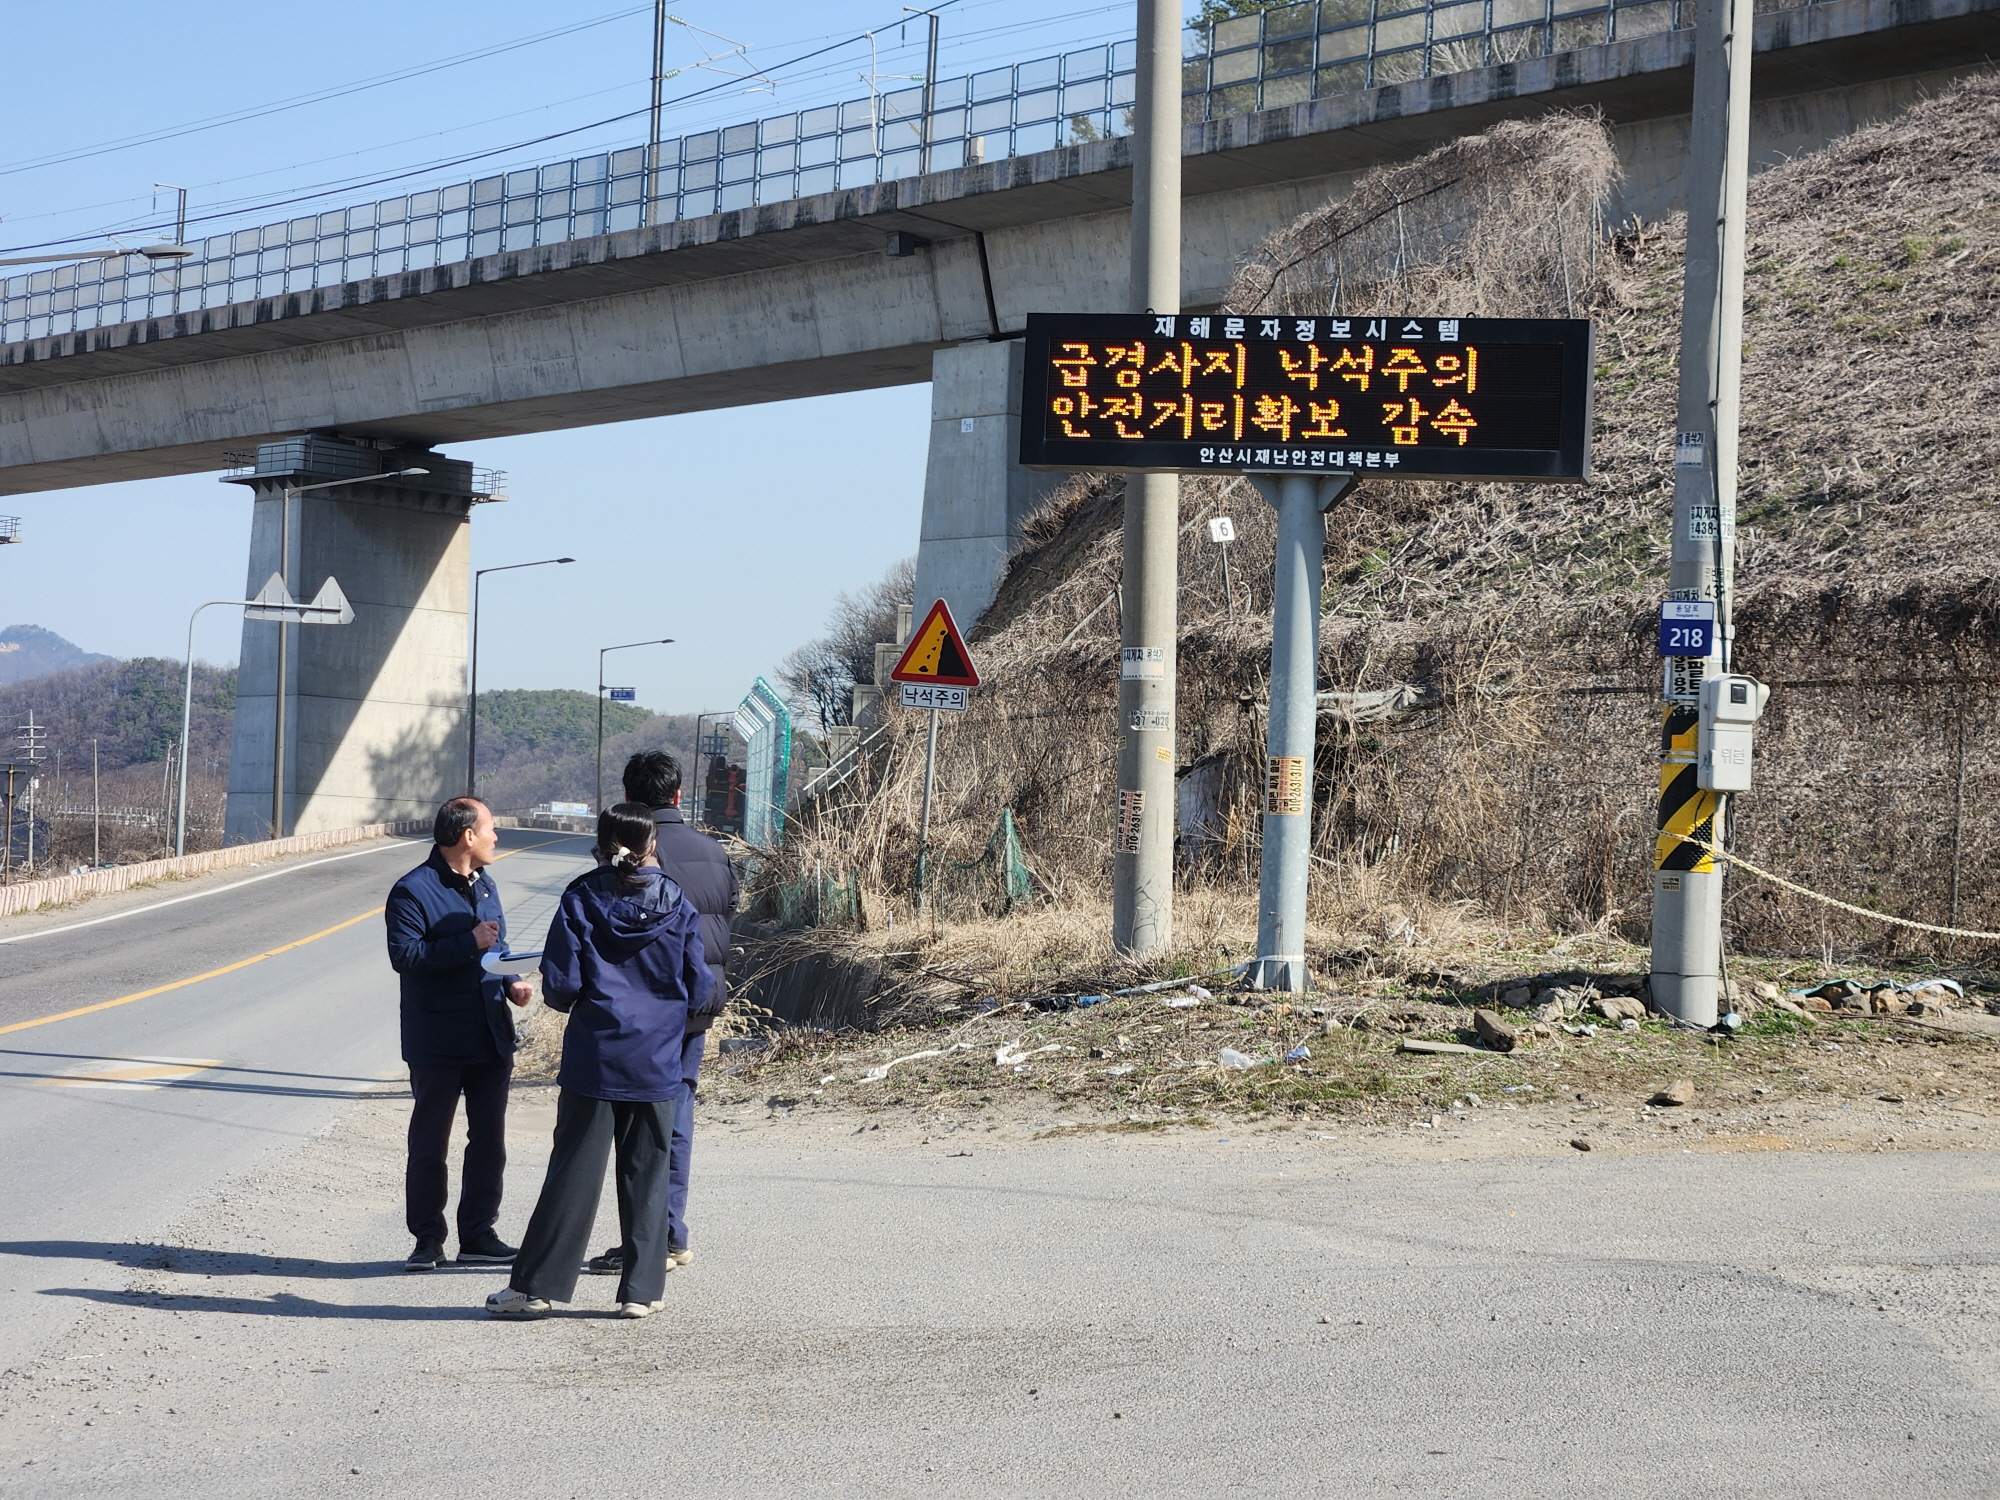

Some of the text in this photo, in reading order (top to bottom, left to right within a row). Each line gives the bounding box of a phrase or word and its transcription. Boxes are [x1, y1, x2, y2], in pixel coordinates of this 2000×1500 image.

[1052, 341, 1478, 394] 급경사지 낙석주의
[1053, 391, 1478, 446] 안전거리확보 감속
[1200, 447, 1400, 468] 안산시재난안전대책본부
[1220, 522, 1228, 536] 6
[1670, 627, 1703, 648] 218
[905, 687, 965, 708] 낙석주의
[1128, 793, 1143, 851] 010-2631-3114
